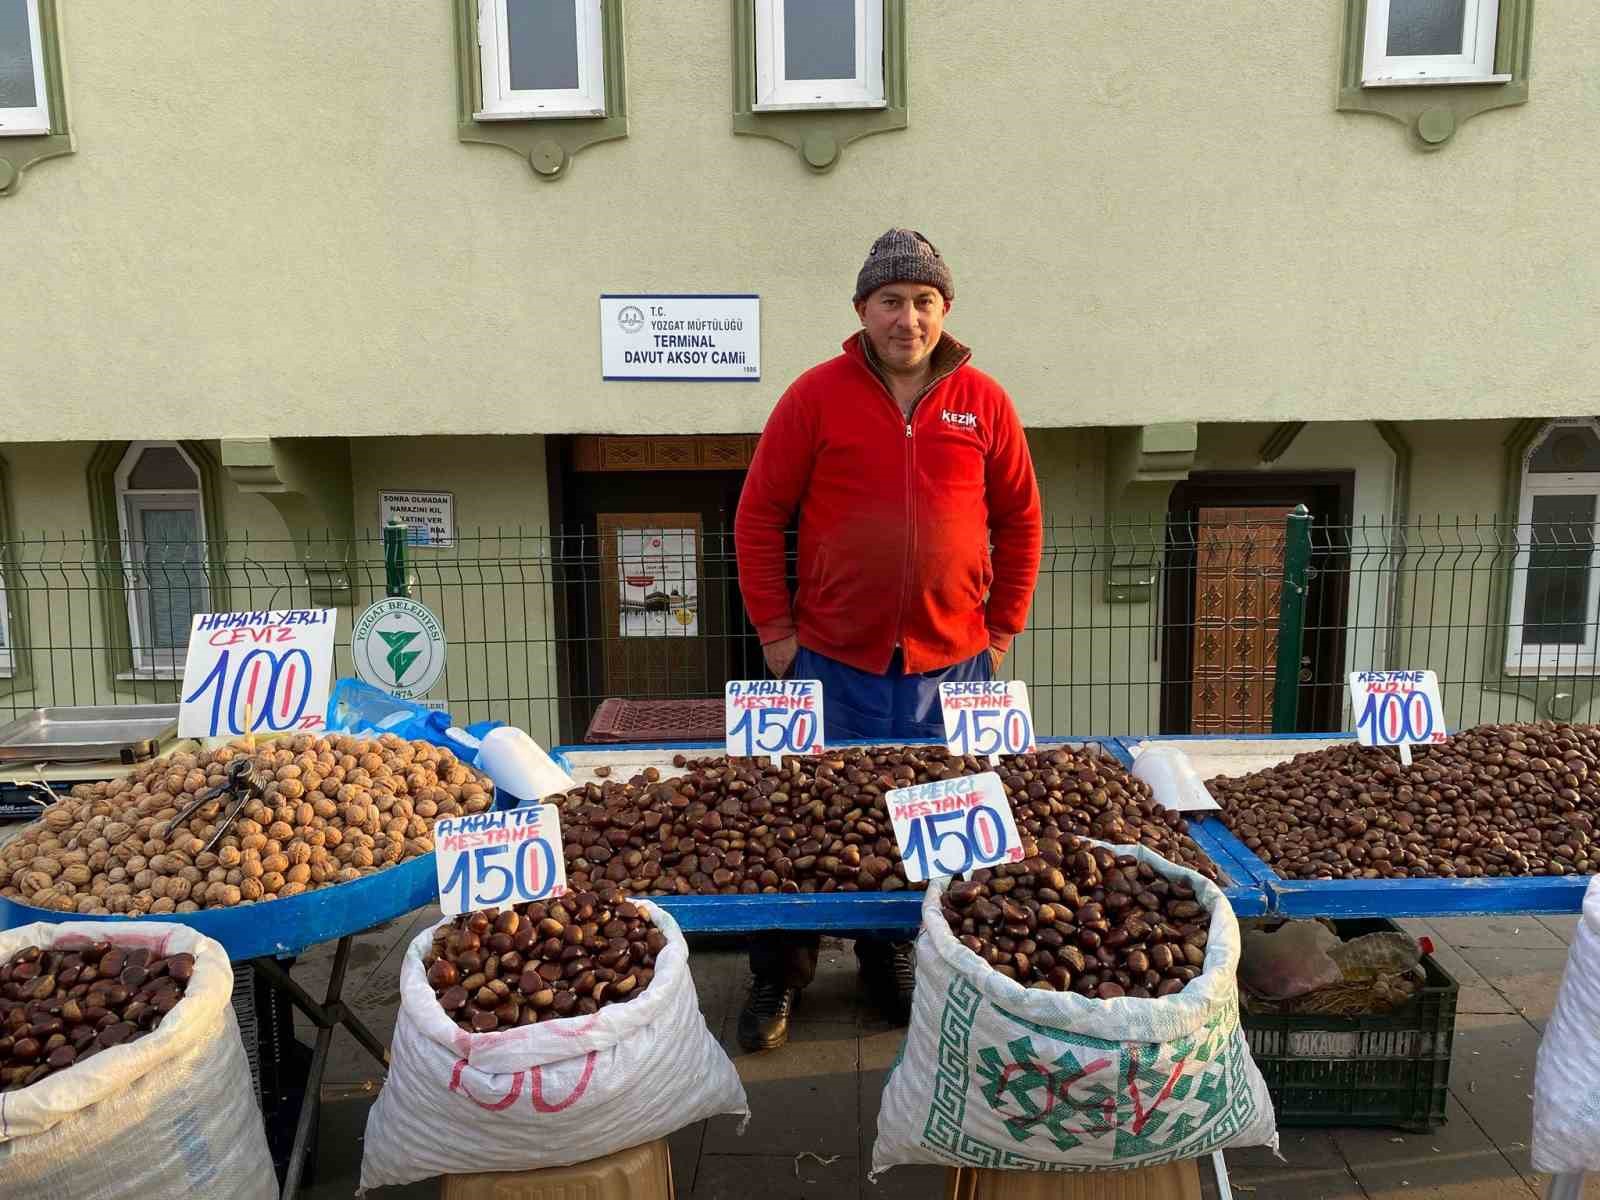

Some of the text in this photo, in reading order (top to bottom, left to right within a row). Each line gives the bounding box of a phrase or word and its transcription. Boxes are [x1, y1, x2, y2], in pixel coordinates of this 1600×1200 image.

[650, 306, 666, 317] T.C.
[651, 318, 743, 331] YOZGAT MÜFTÜLÜĞÜ
[624, 351, 664, 364] DAVUT
[667, 351, 710, 364] AKSOY
[384, 495, 448, 505] SONRA OLMADAN
[357, 605, 386, 641] YOZGAT
[1358, 671, 1424, 683] KESTANE
[1366, 682, 1414, 694] KUZU
[185, 648, 312, 737] 100
[733, 695, 815, 709] KESTANE
[944, 695, 1013, 709] KESTANE
[948, 708, 1030, 754] 150
[1357, 690, 1433, 747] 100
[728, 707, 817, 758] 150
[894, 791, 985, 821] KESTANE
[443, 824, 544, 851] KESTANE
[902, 805, 1007, 881] 150
[441, 838, 556, 913] 150
